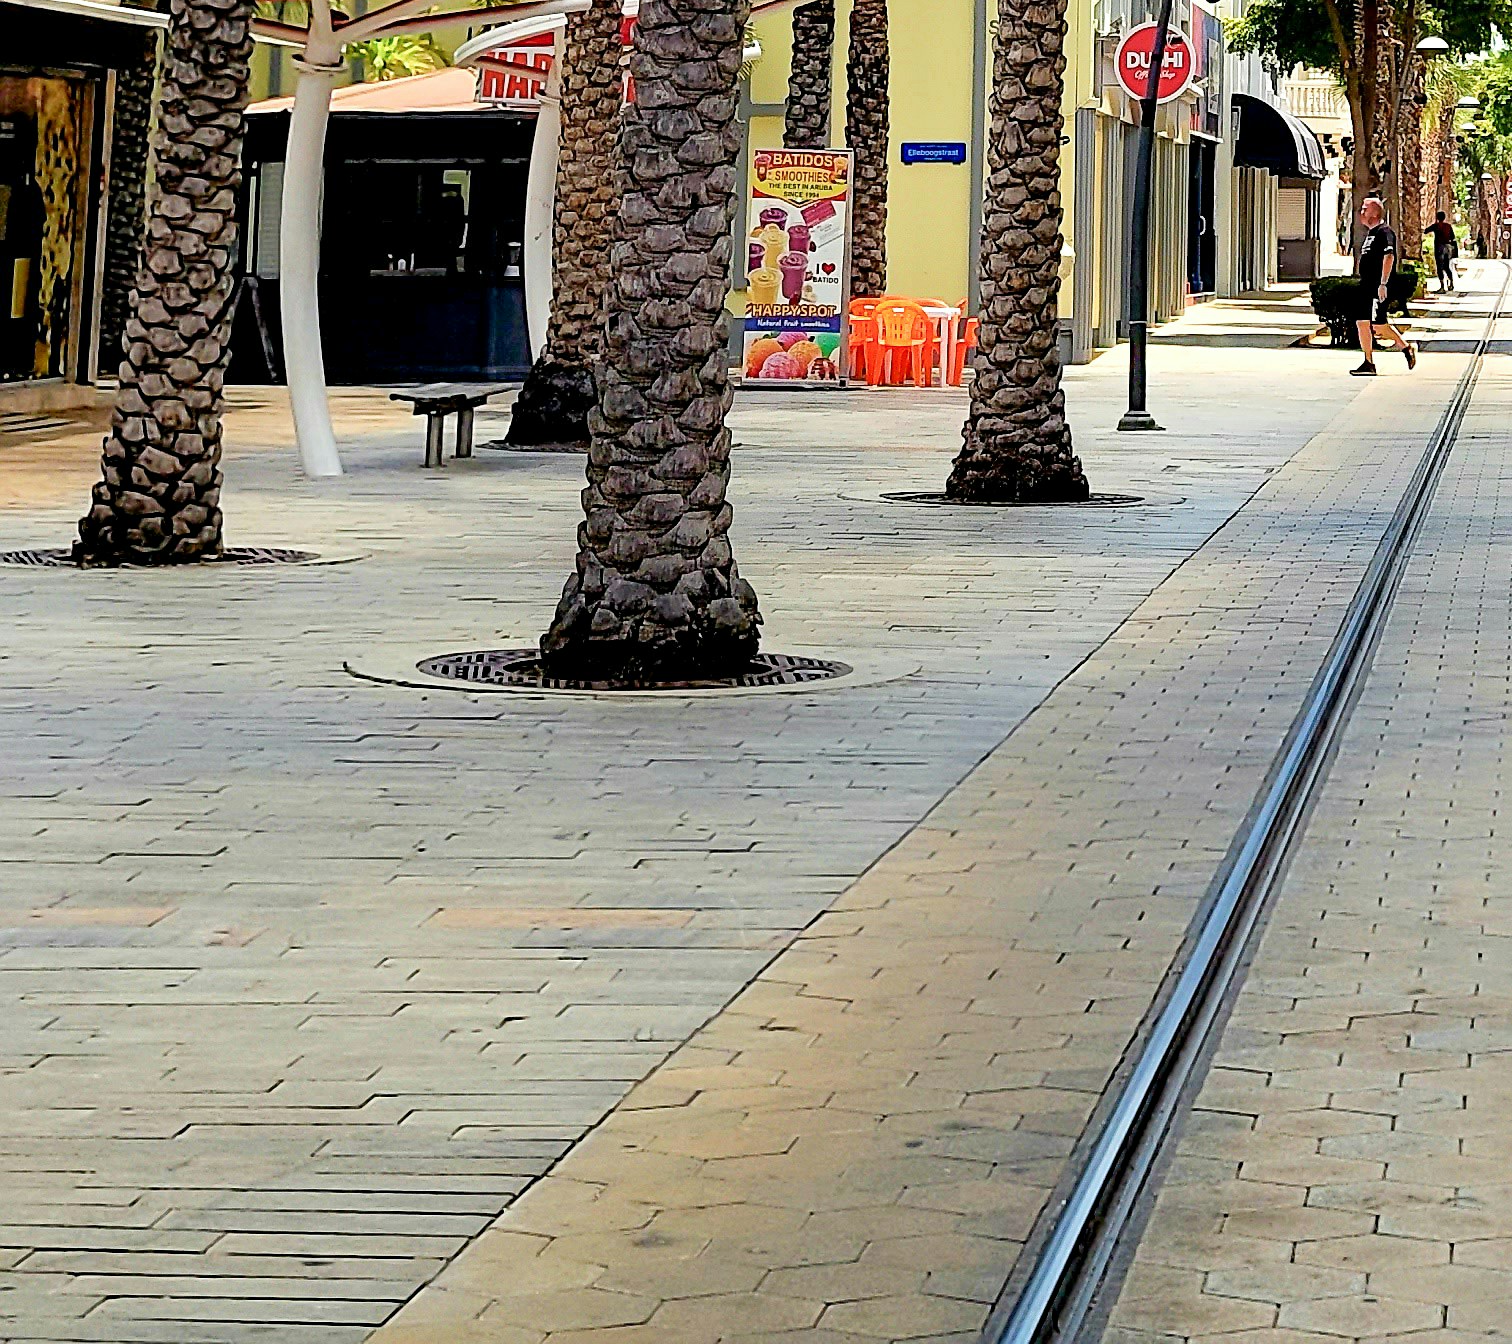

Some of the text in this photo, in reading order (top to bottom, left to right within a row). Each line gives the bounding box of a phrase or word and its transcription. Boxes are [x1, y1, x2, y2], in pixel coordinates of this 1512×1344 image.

[1126, 51, 1183, 69] DUHI
[773, 153, 833, 167] BATIDOS
[775, 170, 829, 183] SMOOTHIES
[816, 263, 820, 275] I
[812, 276, 839, 285] BATIDO
[752, 303, 836, 318] HAPPY SPOT
[757, 319, 782, 327] Natural
[783, 319, 800, 327] fruit
